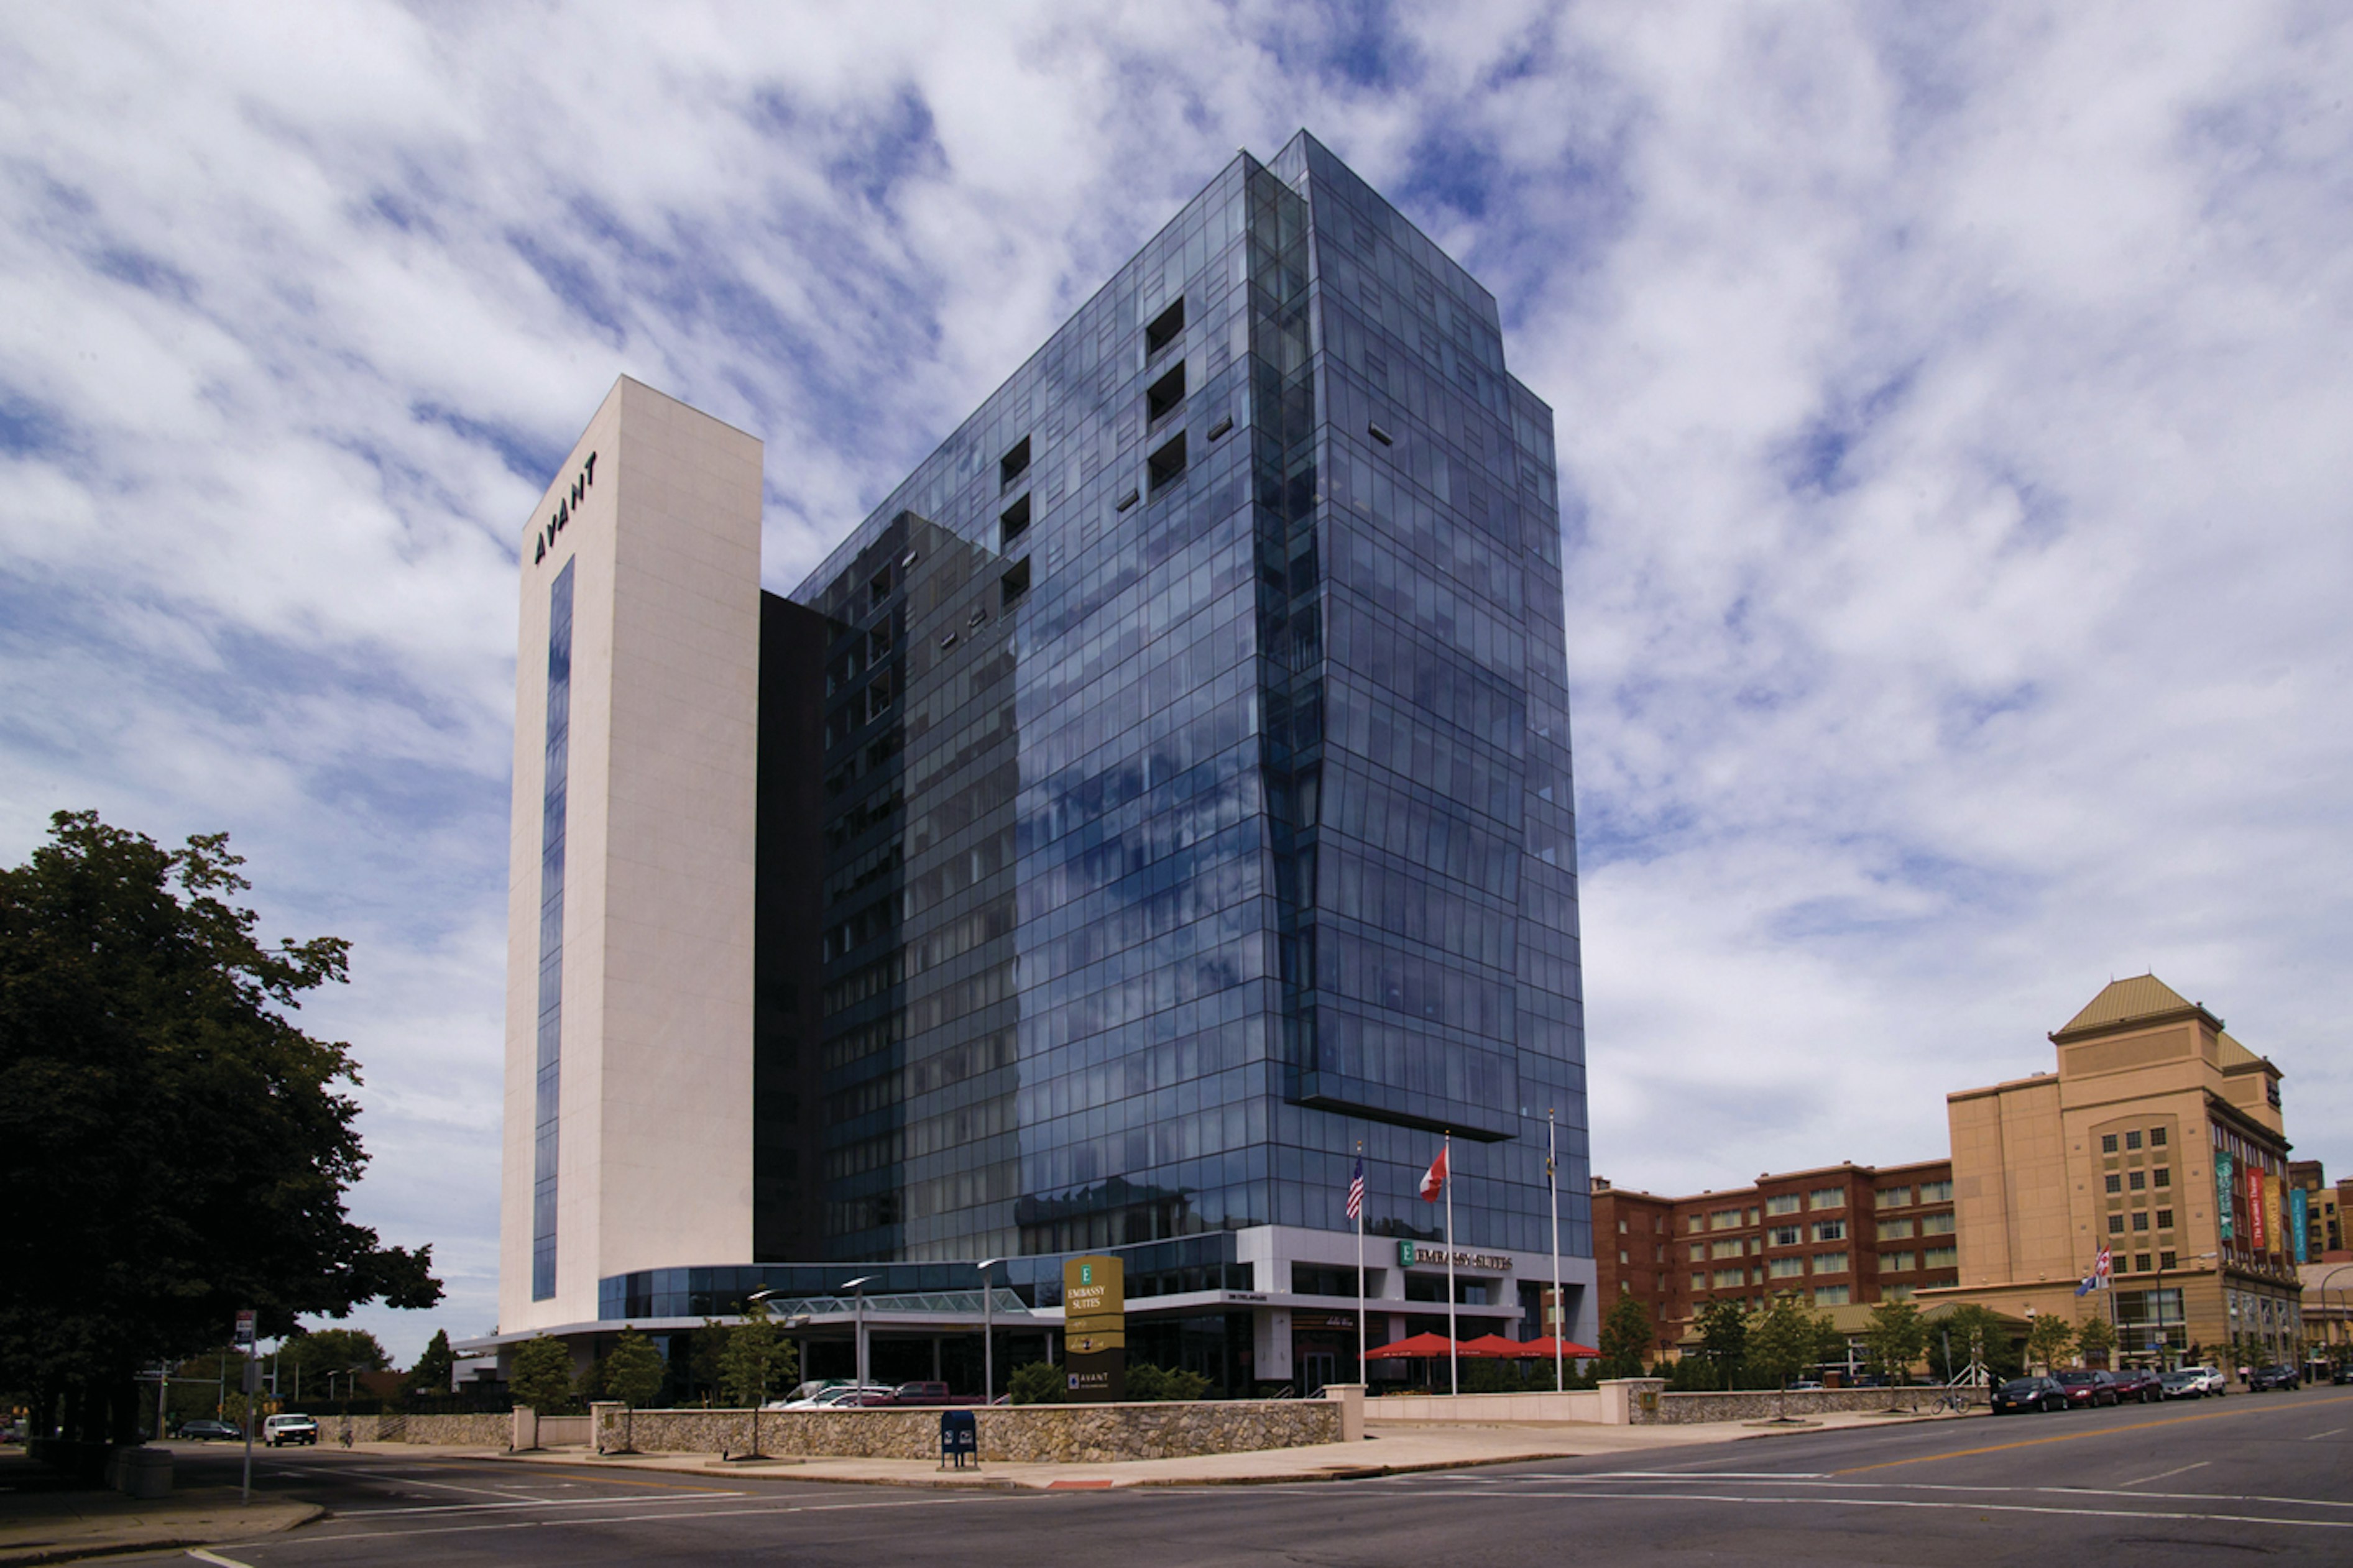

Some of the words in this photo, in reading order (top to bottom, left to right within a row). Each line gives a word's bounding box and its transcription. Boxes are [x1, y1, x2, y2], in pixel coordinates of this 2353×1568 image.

[535, 451, 597, 564] AVANT
[1404, 1245, 1411, 1261] E
[1473, 1254, 1513, 1270] SUITES
[1083, 1268, 1090, 1281] E
[1067, 1285, 1105, 1299] EMBASSY
[1072, 1297, 1100, 1309] SUITES
[1080, 1372, 1108, 1382] AVANT
